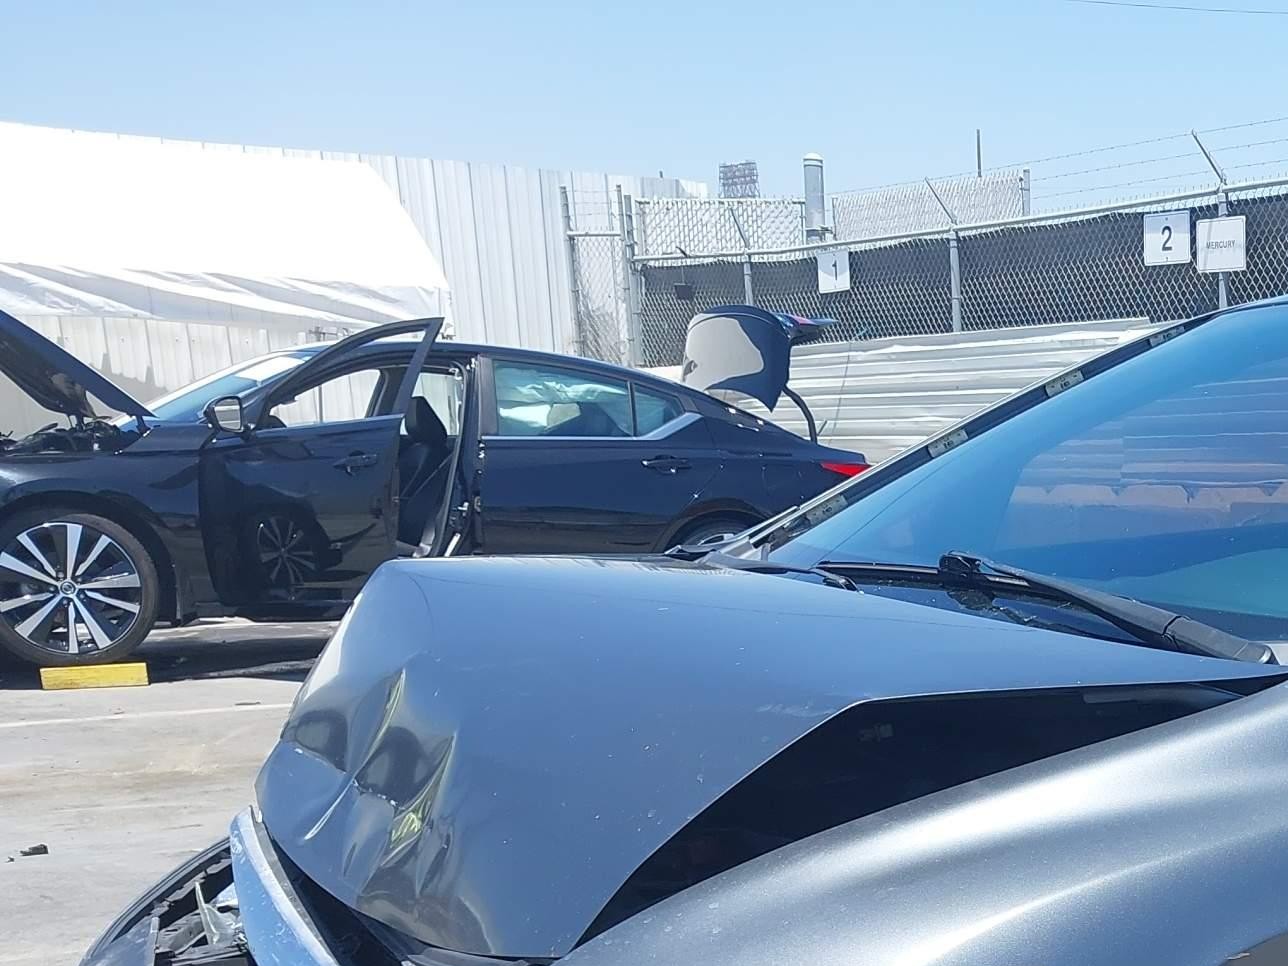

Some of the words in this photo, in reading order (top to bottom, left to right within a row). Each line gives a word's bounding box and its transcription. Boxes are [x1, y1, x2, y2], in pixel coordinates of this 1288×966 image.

[1161, 225, 1173, 252] 2
[1206, 240, 1236, 250] MERCURY
[832, 260, 838, 281] 1
